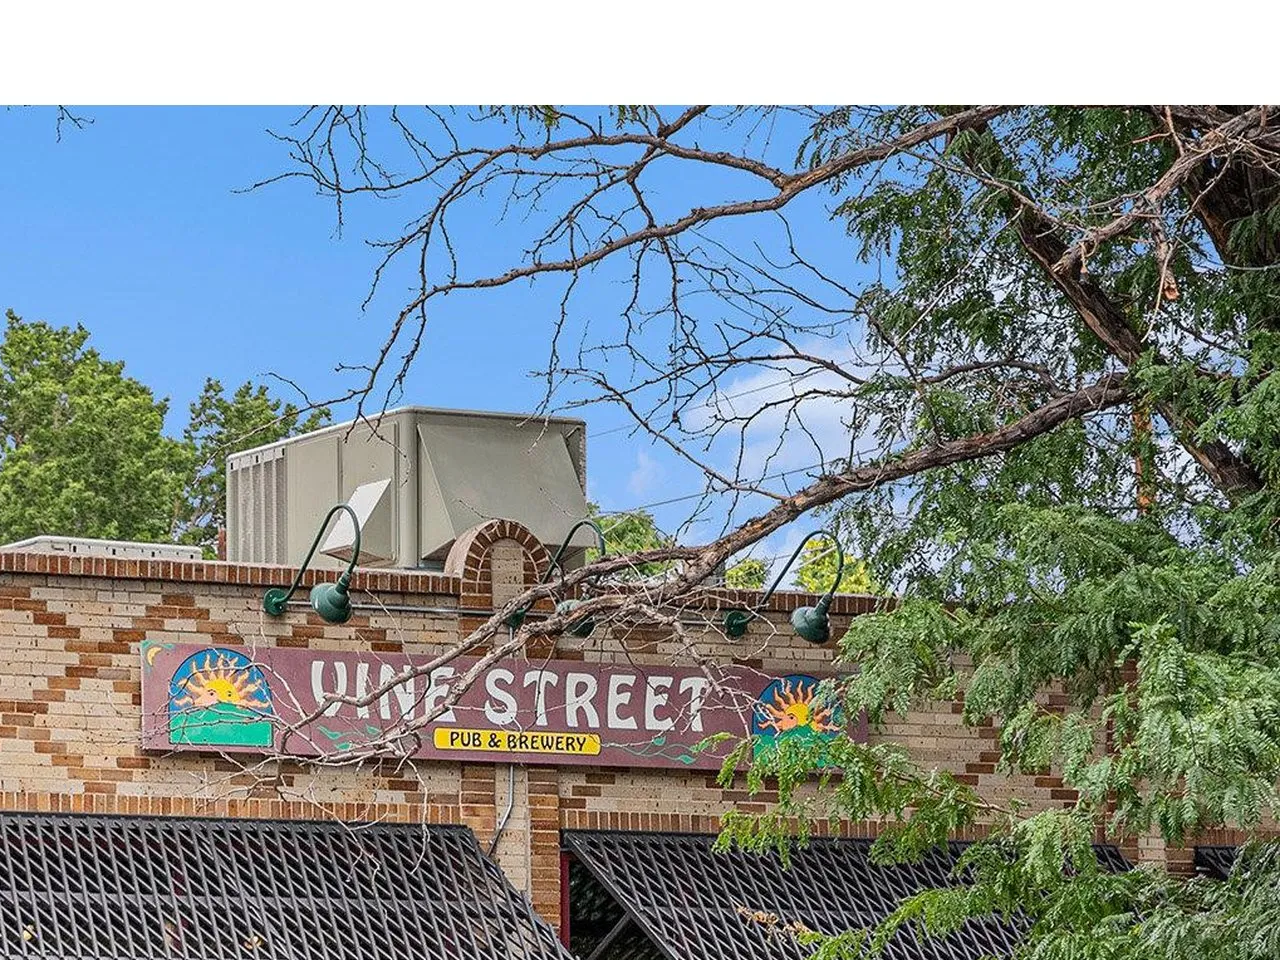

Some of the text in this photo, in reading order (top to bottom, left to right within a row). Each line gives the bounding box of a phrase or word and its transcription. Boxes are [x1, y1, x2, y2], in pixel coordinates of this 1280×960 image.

[311, 660, 708, 732] VINE STREET
[450, 731, 587, 750] PUB & BREWERY
